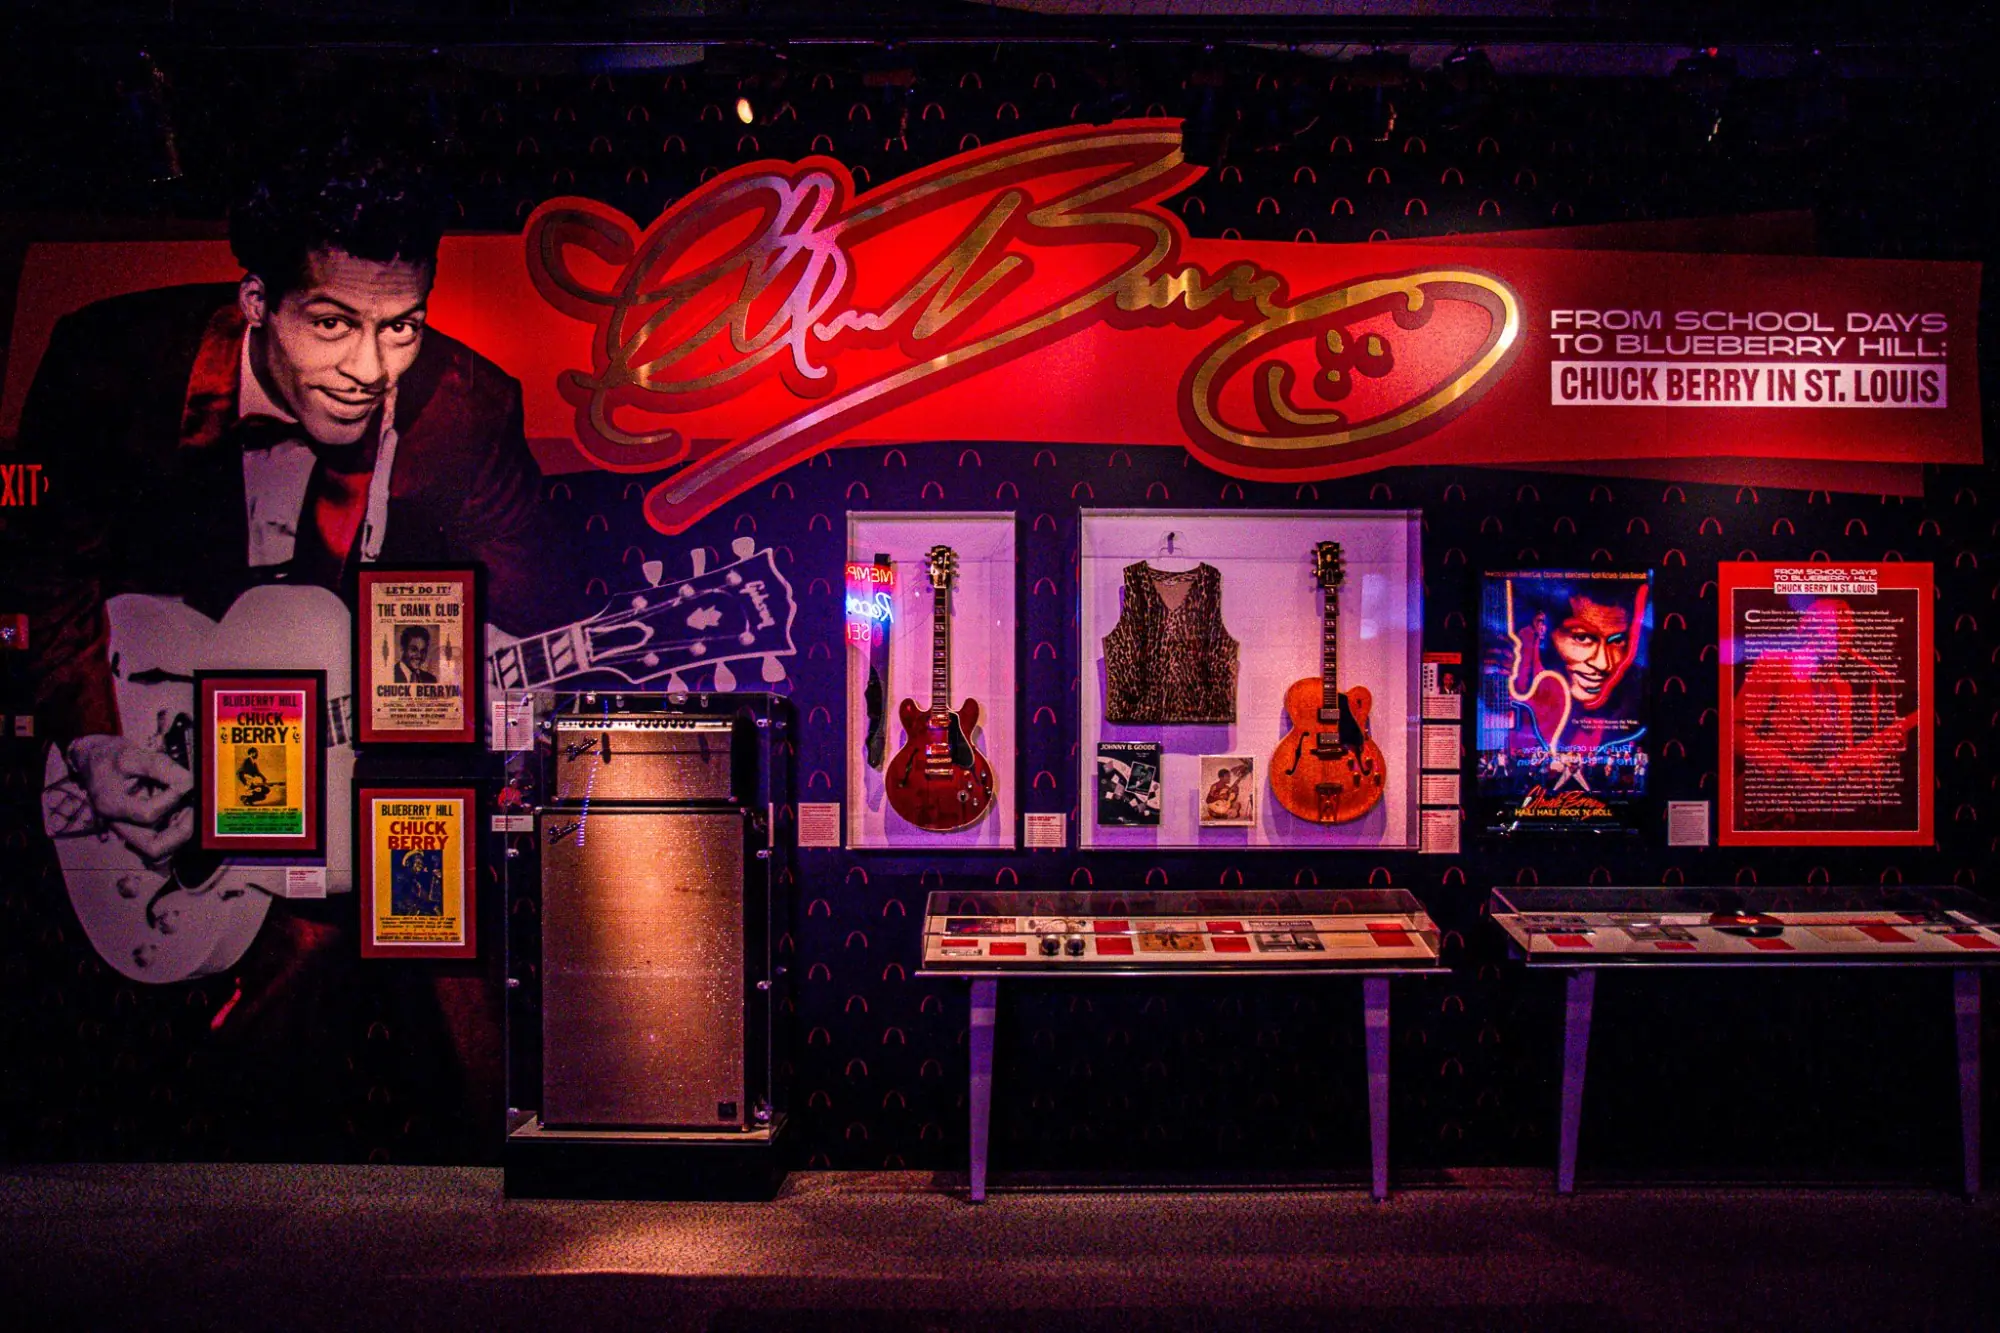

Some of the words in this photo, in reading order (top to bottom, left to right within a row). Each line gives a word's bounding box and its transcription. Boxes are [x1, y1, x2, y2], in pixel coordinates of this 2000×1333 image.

[1550, 310, 1662, 330] FROM
[1674, 311, 1835, 332] SCHOOL
[1846, 312, 1948, 333] DAYS
[1550, 334, 1603, 354] TO
[1616, 335, 1845, 357] BLUEBERRY
[1859, 336, 1947, 357] HILL:
[1560, 366, 1659, 401] CHUCK
[1666, 368, 1760, 402] BERRY
[1766, 369, 1796, 402] IN
[1804, 369, 1846, 402] ST.
[1854, 369, 1940, 403] LOUIS
[0, 464, 42, 506] XIT
[386, 586, 415, 595] LET'S
[418, 586, 433, 595] DO
[1776, 584, 1802, 593] CHUCK
[1804, 584, 1828, 593] BERRY
[1830, 584, 1838, 593] IN
[1840, 584, 1851, 593] ST.
[1852, 584, 1876, 593] LOUIS
[377, 603, 397, 617] THE
[400, 603, 431, 617] CRANK
[435, 603, 460, 617] CLUB
[376, 685, 412, 697] CHUCK
[223, 695, 275, 707] BLUEBERRY
[279, 695, 297, 707] HILL
[237, 711, 285, 726] CHUCK
[231, 727, 289, 743] BERRY
[381, 804, 431, 816] BLUEBERRY
[436, 804, 454, 816] HILL
[1559, 808, 1580, 816] ROCK
[1592, 808, 1613, 816] ROLL
[390, 821, 447, 835] CHUCK
[388, 836, 449, 850] BERRY
